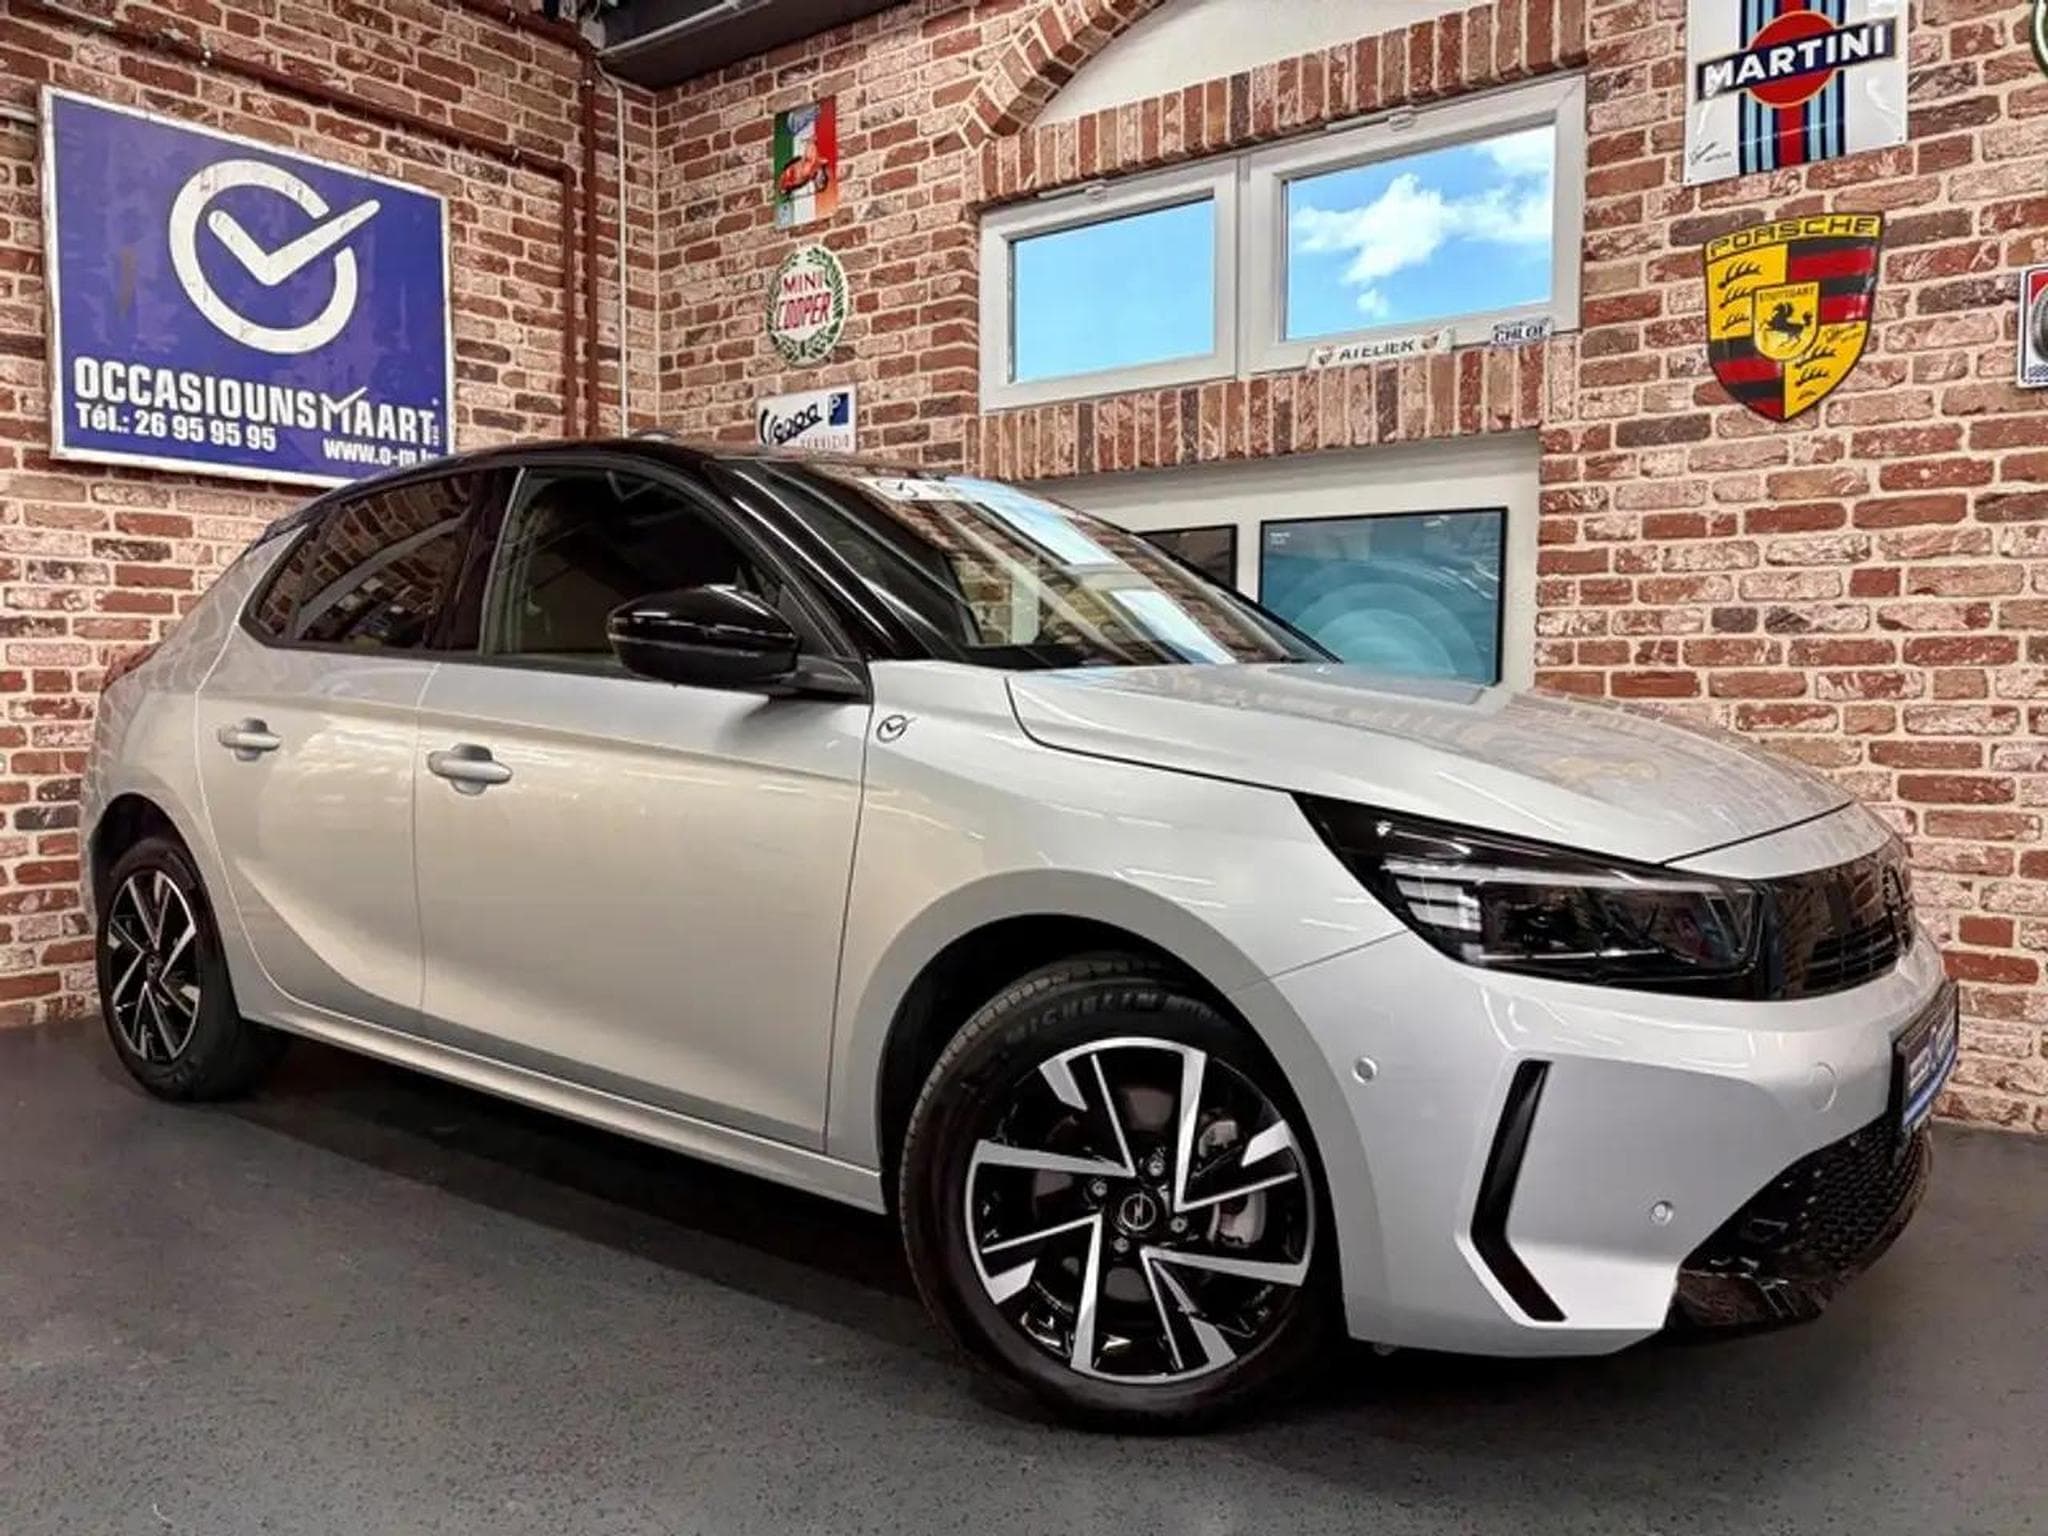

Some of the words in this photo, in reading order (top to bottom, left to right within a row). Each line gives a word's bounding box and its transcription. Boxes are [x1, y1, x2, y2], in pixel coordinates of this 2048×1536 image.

[1703, 25, 1886, 97] MARTINI
[1710, 217, 1877, 257] PORSCHE
[783, 270, 823, 294] MINI
[776, 292, 831, 331] COOPER
[134, 409, 168, 438] 26
[171, 415, 205, 442] 95
[209, 419, 242, 447] 95
[246, 424, 277, 452] 95
